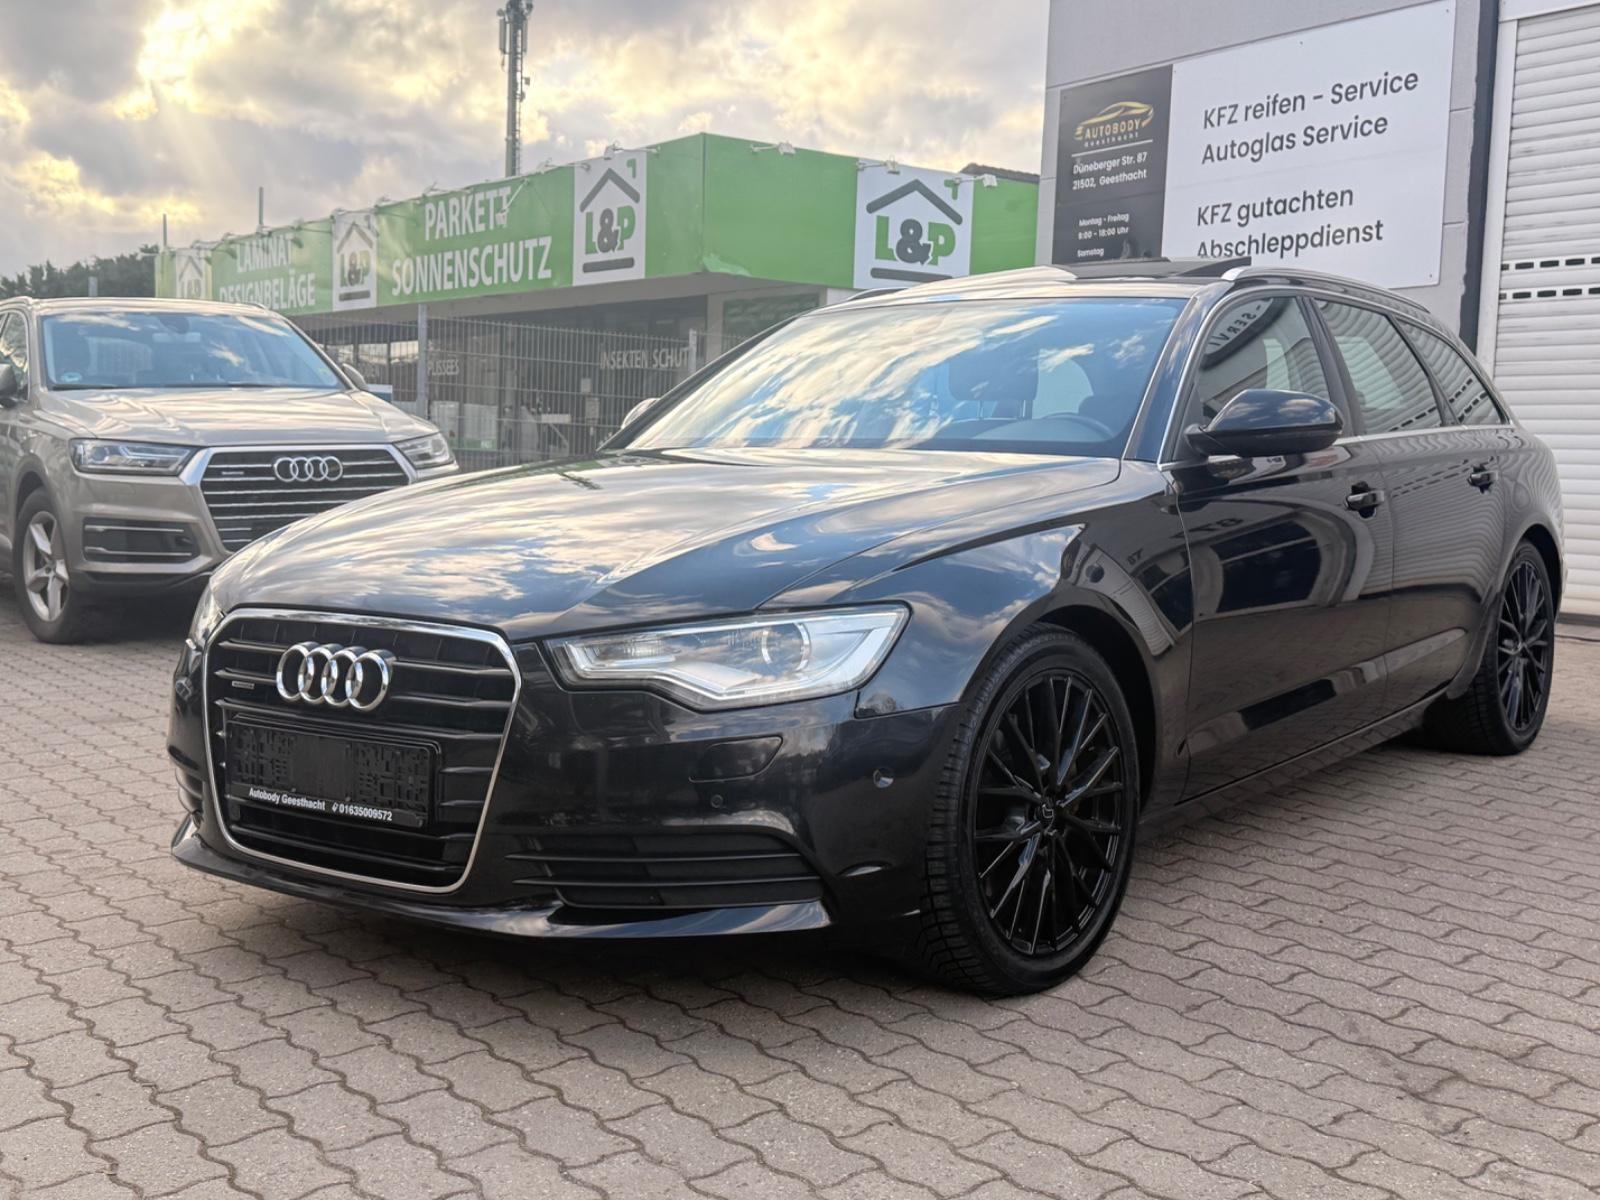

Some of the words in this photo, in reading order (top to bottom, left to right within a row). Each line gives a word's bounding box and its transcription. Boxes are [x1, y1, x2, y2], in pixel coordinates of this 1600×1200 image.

[1203, 102, 1239, 129] KFZ
[1244, 91, 1306, 123] reifen
[1331, 69, 1419, 106] Service
[1084, 119, 1141, 139] AUTOBODY
[1201, 130, 1296, 165] Autoglas
[1302, 114, 1389, 147] Service
[1072, 177, 1096, 190] 21502,
[1099, 169, 1147, 186] Geesthacht
[1073, 158, 1120, 174] Düneberger
[1122, 155, 1135, 166] Str.
[1137, 151, 1148, 163] 87
[424, 186, 512, 241] PARKETT
[1196, 202, 1232, 227] KFZ
[1236, 184, 1354, 228] gutachten
[584, 205, 636, 255] L&P
[874, 214, 956, 267] L&P
[1197, 219, 1383, 259] Abschleppdienst
[236, 232, 295, 274] LAMINAT
[391, 235, 553, 297] SONNENSCHUTZ
[652, 346, 690, 369] SCHUT
[249, 787, 280, 804] Autobody
[281, 794, 326, 811] Geesthacht
[338, 804, 393, 822] 01635009572
